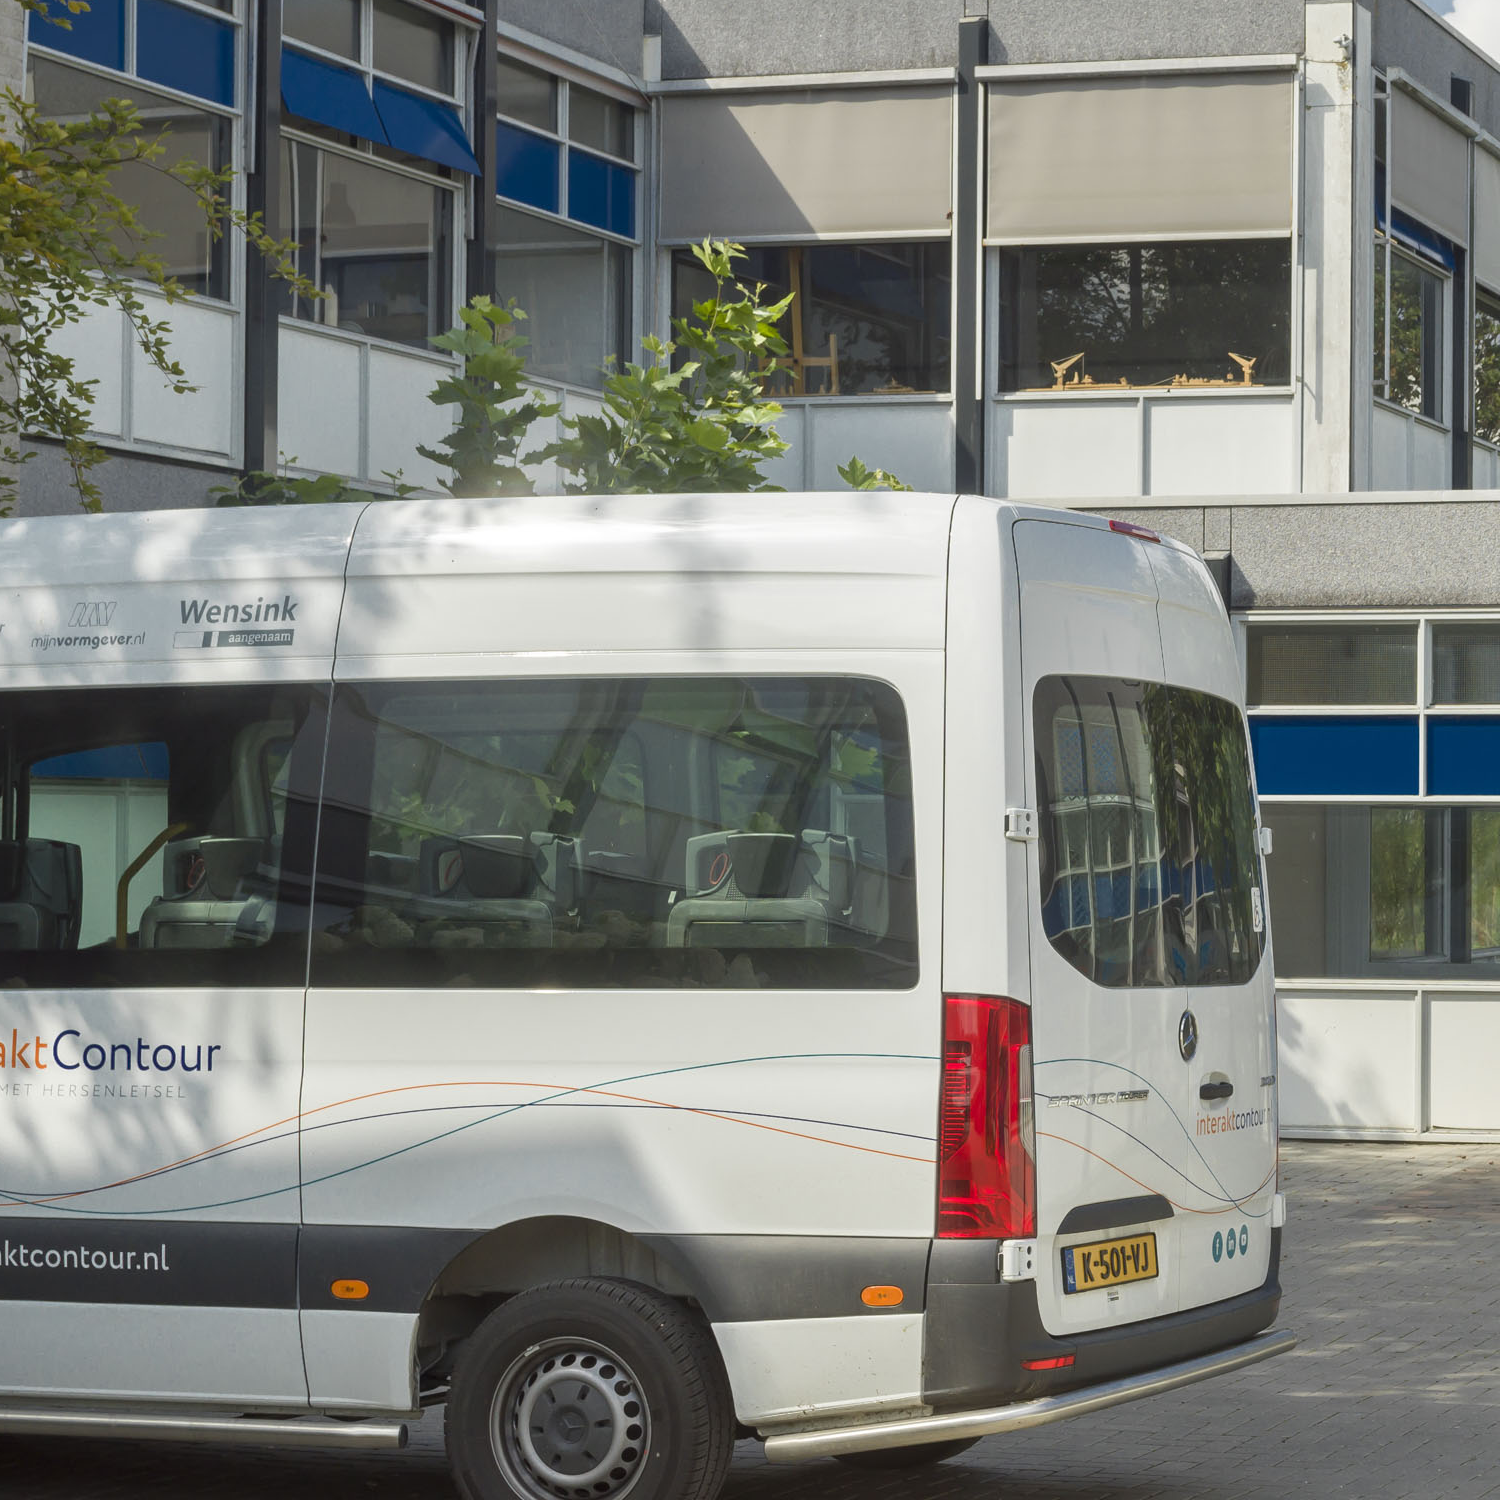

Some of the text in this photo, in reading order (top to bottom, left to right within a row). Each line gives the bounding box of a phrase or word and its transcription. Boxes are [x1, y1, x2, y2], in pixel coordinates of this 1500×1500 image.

[180, 595, 298, 625] Wensink
[31, 631, 146, 651] mijnvormgever.nl
[228, 632, 292, 647] aangenaam
[42, 1084, 186, 1099] HERSENLETSEL
[1047, 1090, 1148, 1108] SPRINTER TOURER
[1081, 1241, 1150, 1284] K-501-VJ
